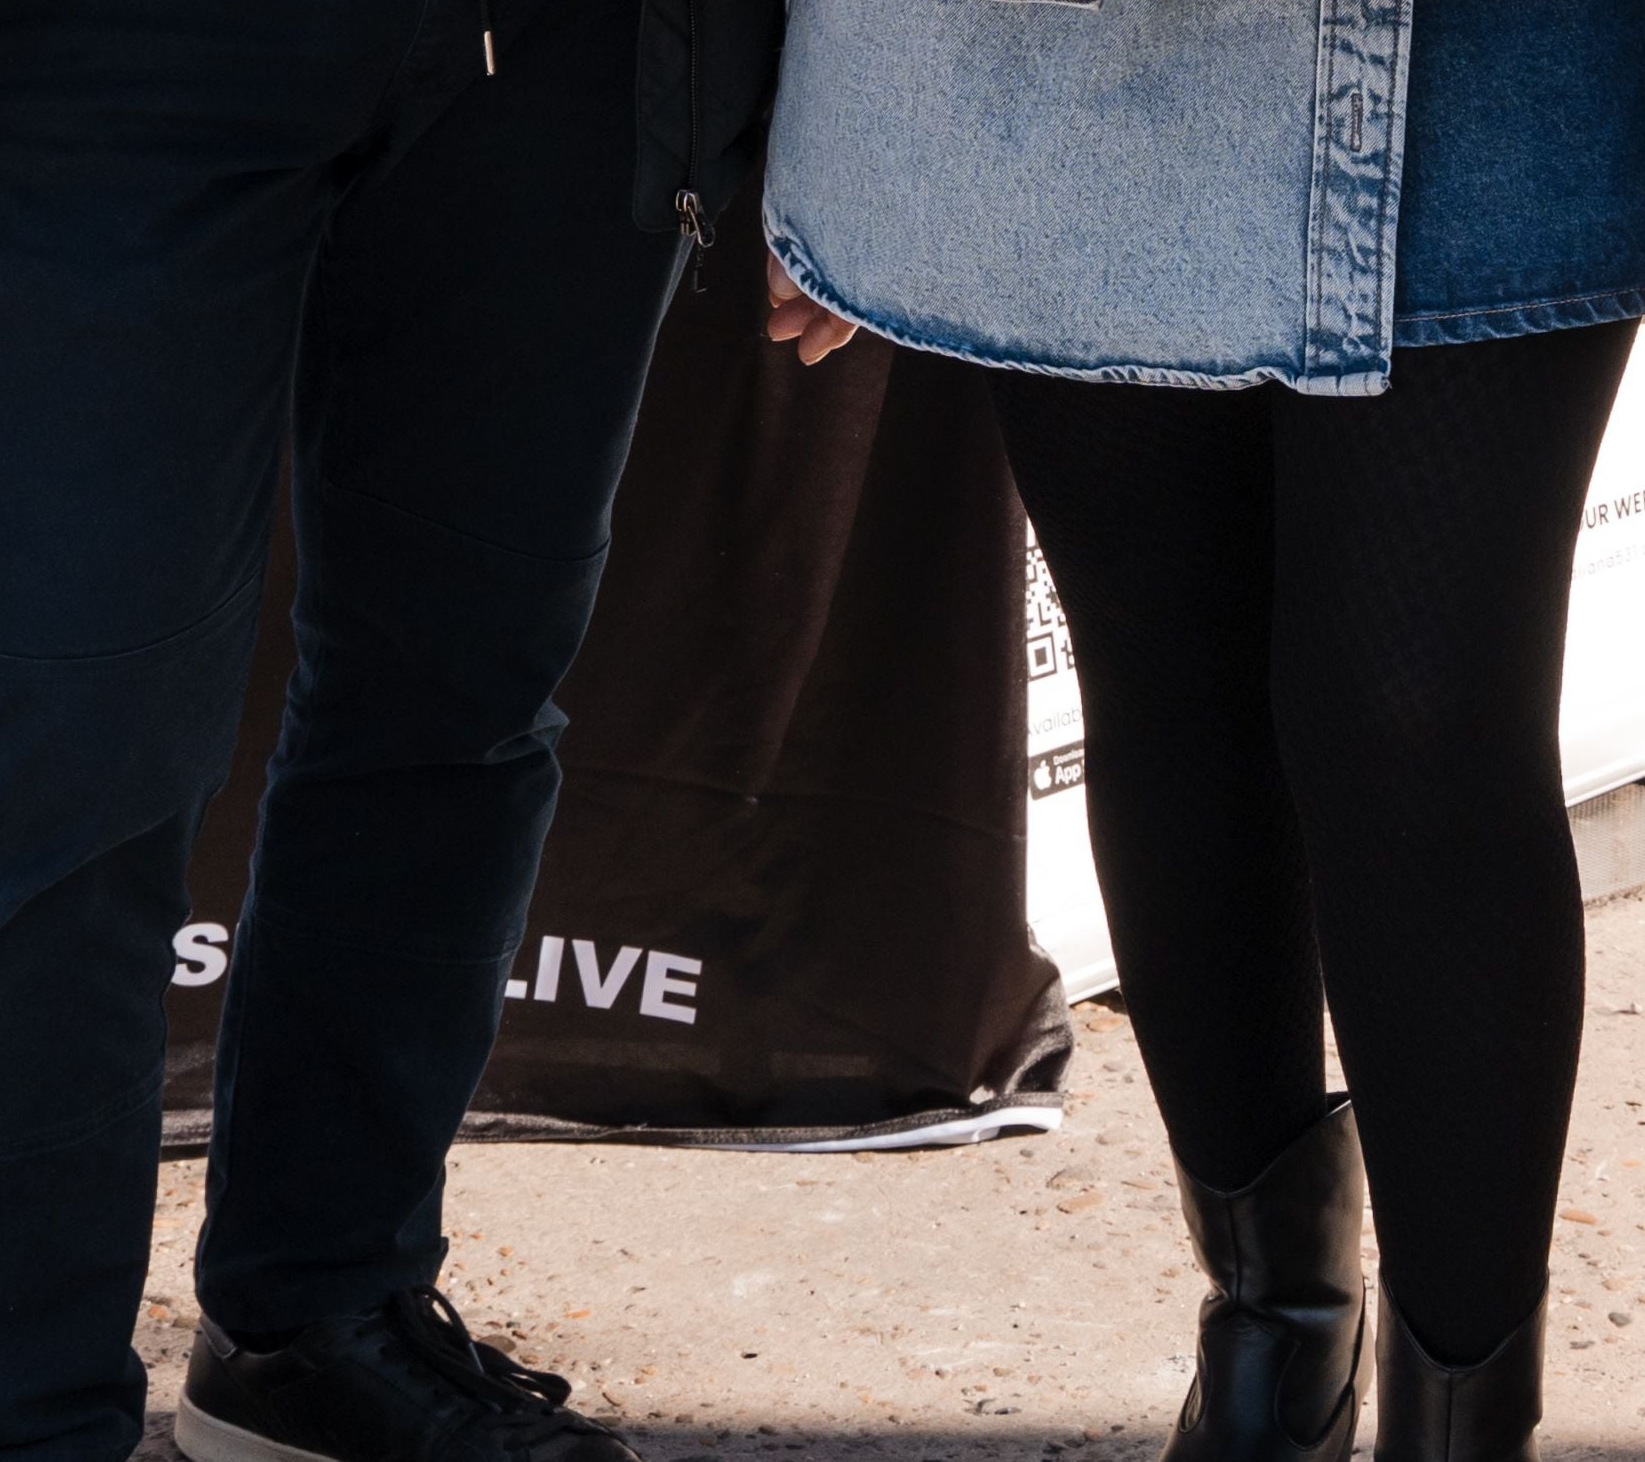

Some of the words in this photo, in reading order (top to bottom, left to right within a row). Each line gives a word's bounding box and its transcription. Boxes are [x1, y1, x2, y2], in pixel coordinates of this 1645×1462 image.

[1581, 504, 1609, 530] UR
[1055, 764, 1081, 784] App
[504, 934, 703, 1024] IVE
